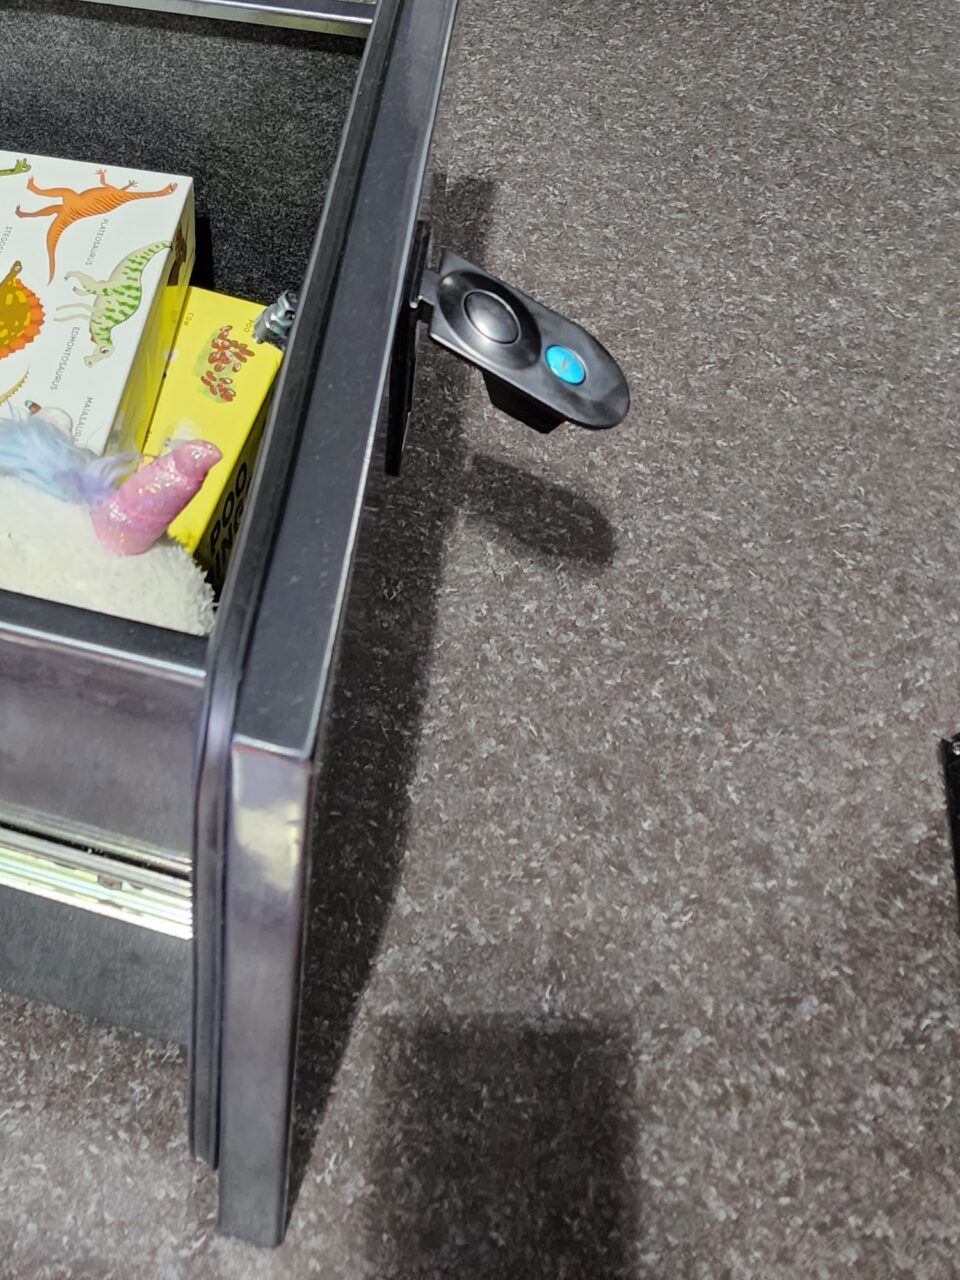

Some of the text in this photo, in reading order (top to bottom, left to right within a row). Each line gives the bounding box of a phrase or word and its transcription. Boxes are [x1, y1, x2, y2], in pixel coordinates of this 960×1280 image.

[85, 218, 109, 266] PLATEOSAURUS
[49, 326, 80, 391] EDMONTOSAURUS
[210, 461, 248, 558] POO
